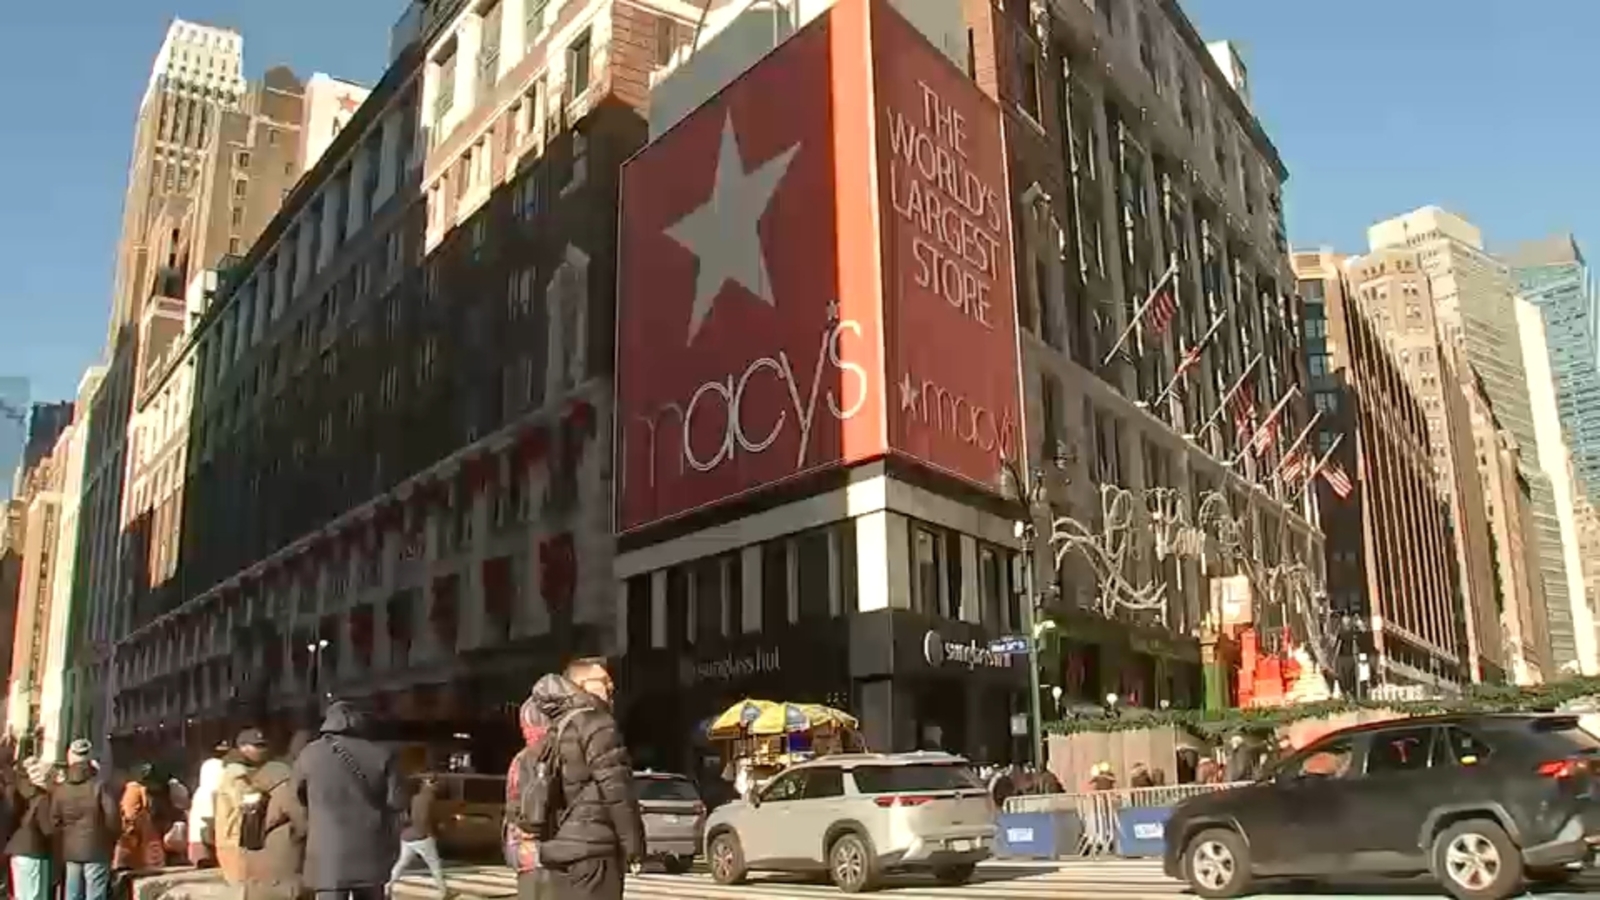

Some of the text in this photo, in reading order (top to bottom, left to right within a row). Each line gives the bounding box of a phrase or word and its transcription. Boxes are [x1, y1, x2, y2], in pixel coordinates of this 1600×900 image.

[886, 105, 1002, 232] WORLD'S
[917, 79, 968, 159] THE
[890, 159, 1001, 281] LARGEST
[912, 236, 994, 330] STORE
